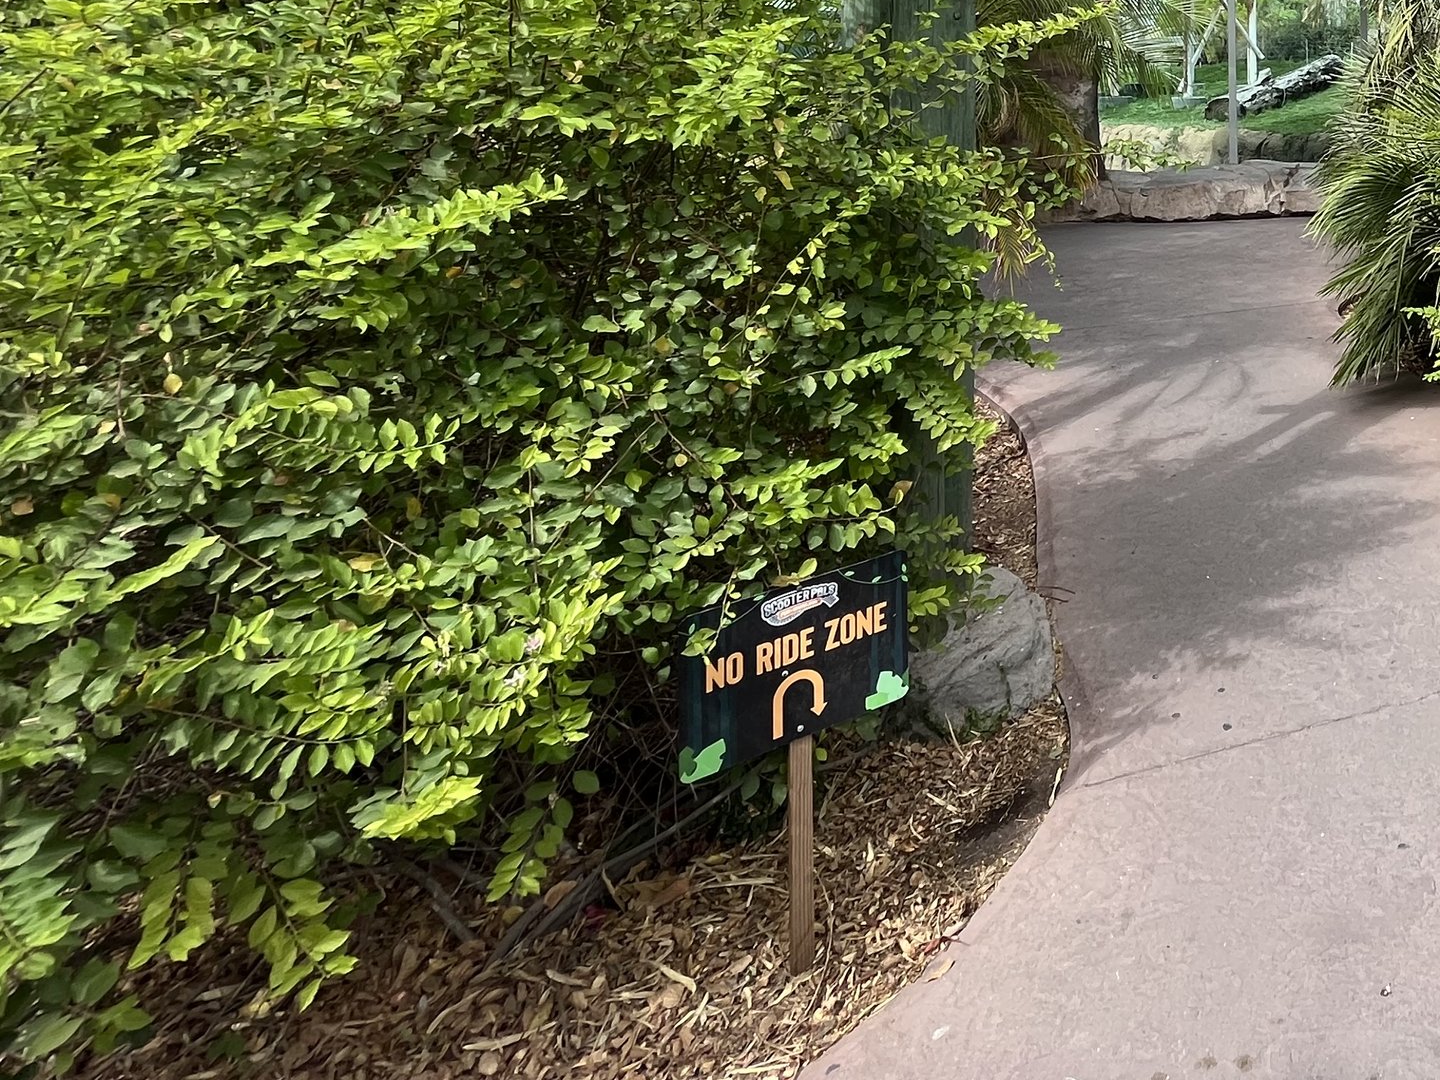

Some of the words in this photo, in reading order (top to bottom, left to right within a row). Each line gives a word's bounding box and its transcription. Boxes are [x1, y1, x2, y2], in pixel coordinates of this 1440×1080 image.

[763, 589, 810, 617] SCOOTER
[705, 651, 744, 694] NO
[756, 626, 815, 675] RIDE
[824, 601, 889, 652] ZONE
